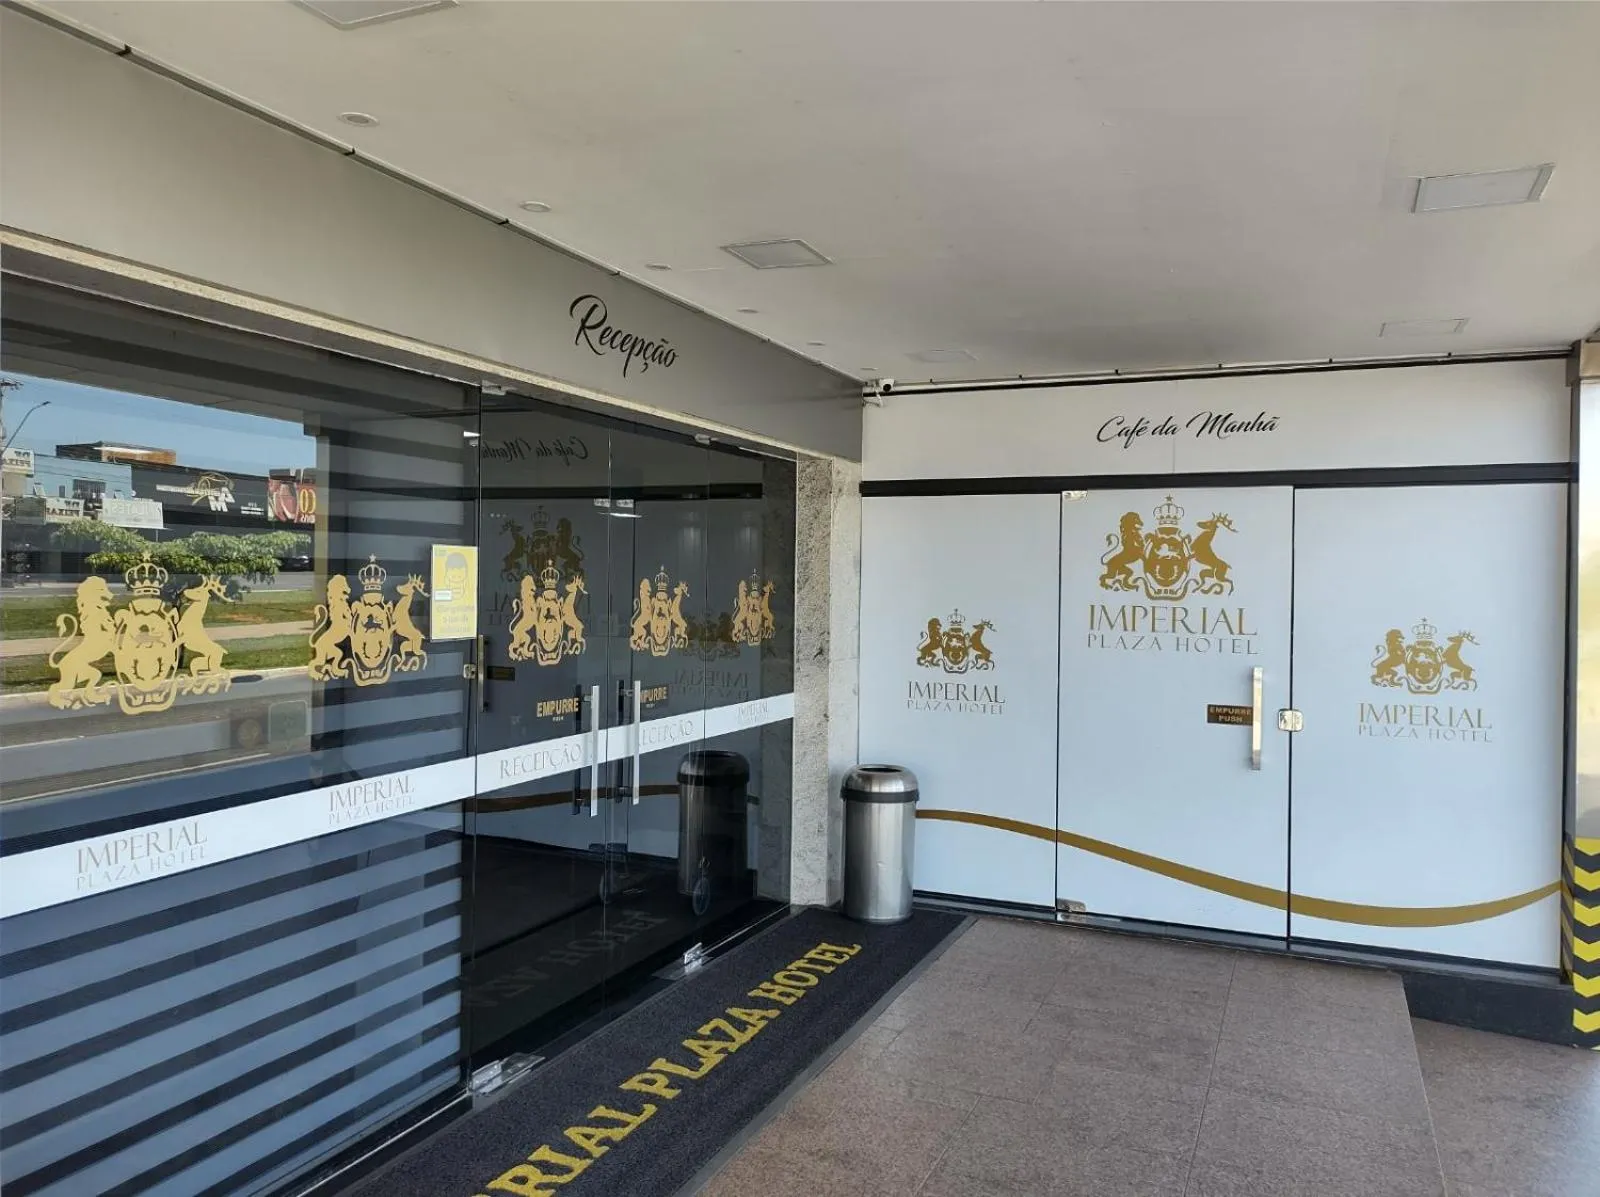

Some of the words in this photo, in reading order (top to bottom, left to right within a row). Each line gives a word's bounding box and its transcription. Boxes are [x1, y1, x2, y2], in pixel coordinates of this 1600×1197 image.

[569, 294, 680, 378] Recepção
[1096, 415, 1150, 449] Café
[1151, 415, 1181, 436] da
[1186, 411, 1281, 440] Manhã
[1088, 604, 1258, 636] IMPERIAL
[1087, 633, 1163, 651] PLAZA
[1175, 636, 1258, 655] HOTEL
[640, 686, 667, 704] MPURRE
[908, 680, 1006, 704] IMPERIAL
[536, 697, 579, 718] EMPURRE
[907, 699, 952, 713] PLAZA
[959, 702, 1003, 716] HOTEL
[1209, 706, 1252, 716] EMPURRE
[1218, 715, 1243, 724] PUSH
[1358, 702, 1493, 729] IMPERIAL
[640, 719, 694, 747] ECEPÇÃO
[1358, 725, 1418, 739] PLAZA
[1428, 728, 1493, 743] HOTEL
[500, 743, 582, 780] RECEPÇÃO
[330, 775, 416, 813] IMPERIAL
[77, 821, 208, 874] IMPERIAL
[76, 862, 141, 890] PLAZA
[149, 845, 206, 873] HOTEL
[471, 1104, 659, 1197] RIAL
[618, 1006, 782, 1100] PLAZA
[747, 942, 863, 1006] HOTEL
